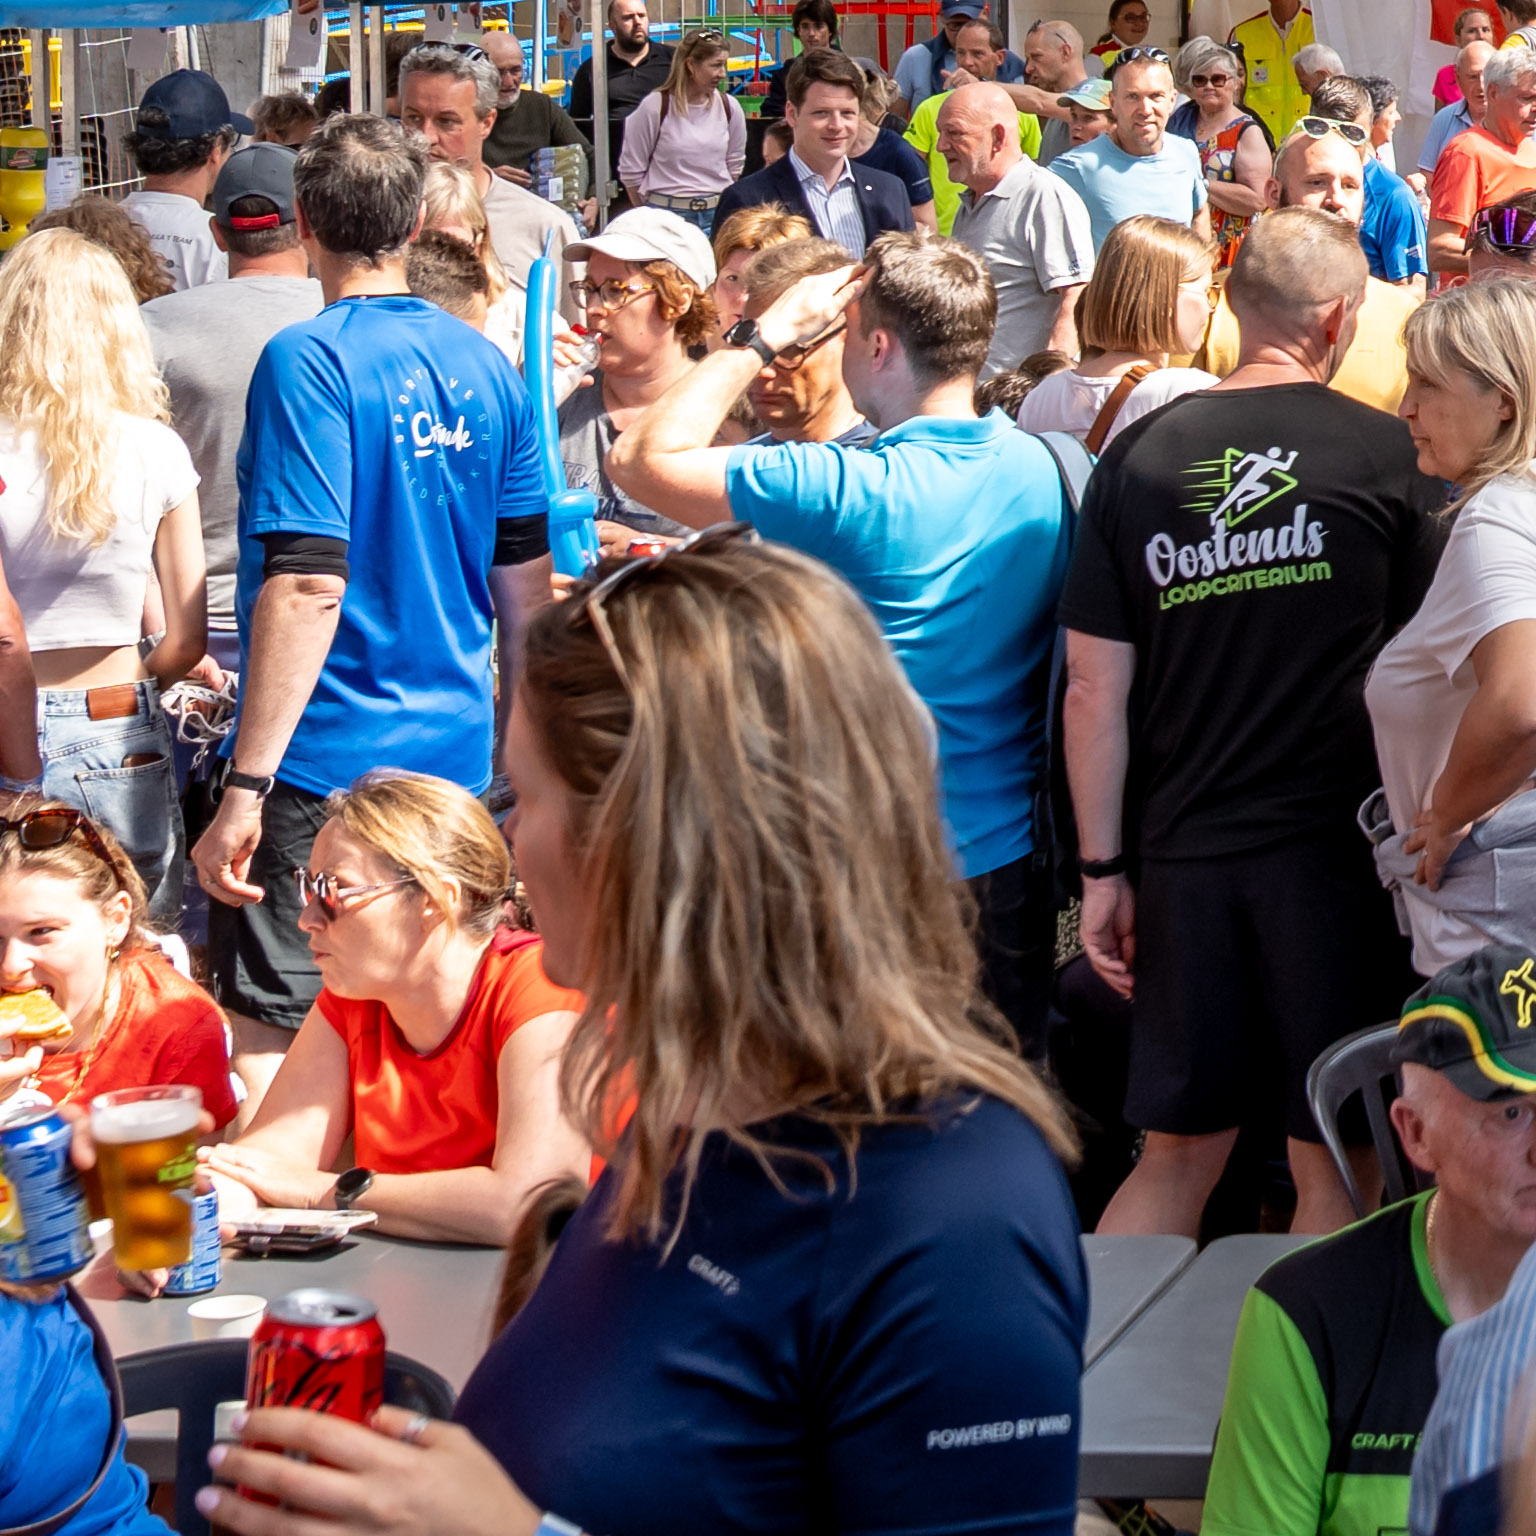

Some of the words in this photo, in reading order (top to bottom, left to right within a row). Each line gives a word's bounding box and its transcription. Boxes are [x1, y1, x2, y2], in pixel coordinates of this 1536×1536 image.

[1145, 503, 1330, 587] Oostends
[1159, 561, 1332, 611] LOOPCRITERIUM
[926, 1420, 1015, 1451] POWERED
[1015, 1417, 1037, 1440] BY
[1351, 1432, 1414, 1451] CRAFT
